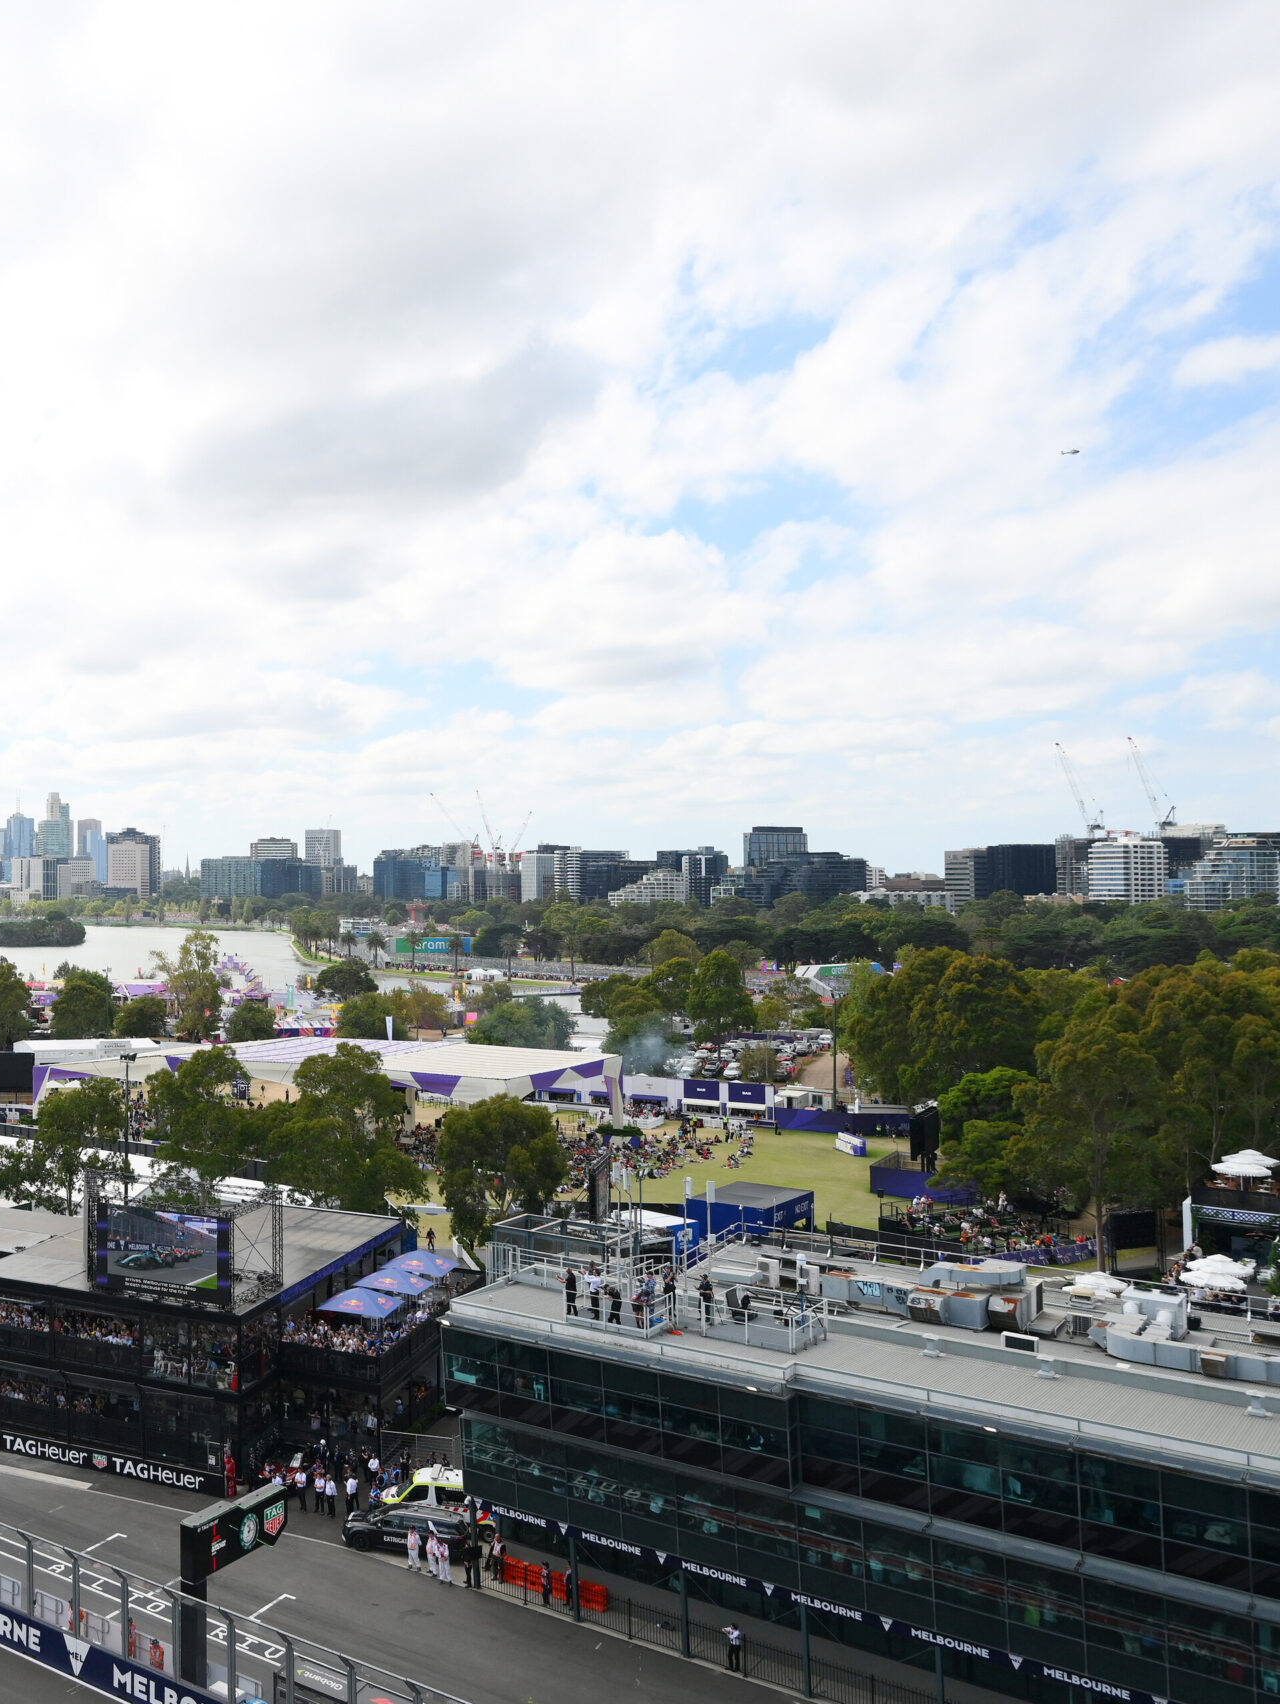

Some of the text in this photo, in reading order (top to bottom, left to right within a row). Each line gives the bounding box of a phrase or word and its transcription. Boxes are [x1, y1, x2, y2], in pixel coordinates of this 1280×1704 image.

[415, 941, 451, 950] aram
[266, 1502, 283, 1518] TAG
[492, 1504, 546, 1528] MELBOURNE
[264, 1514, 284, 1533] HEUER
[582, 1532, 642, 1556] MELBOURNE
[682, 1560, 747, 1588] MELBOURNE
[790, 1592, 862, 1622] MELBOURNE
[910, 1628, 990, 1659] MELBOURNE
[304, 1670, 343, 1691] Globant
[1042, 1666, 1130, 1701] MELBOURNE
